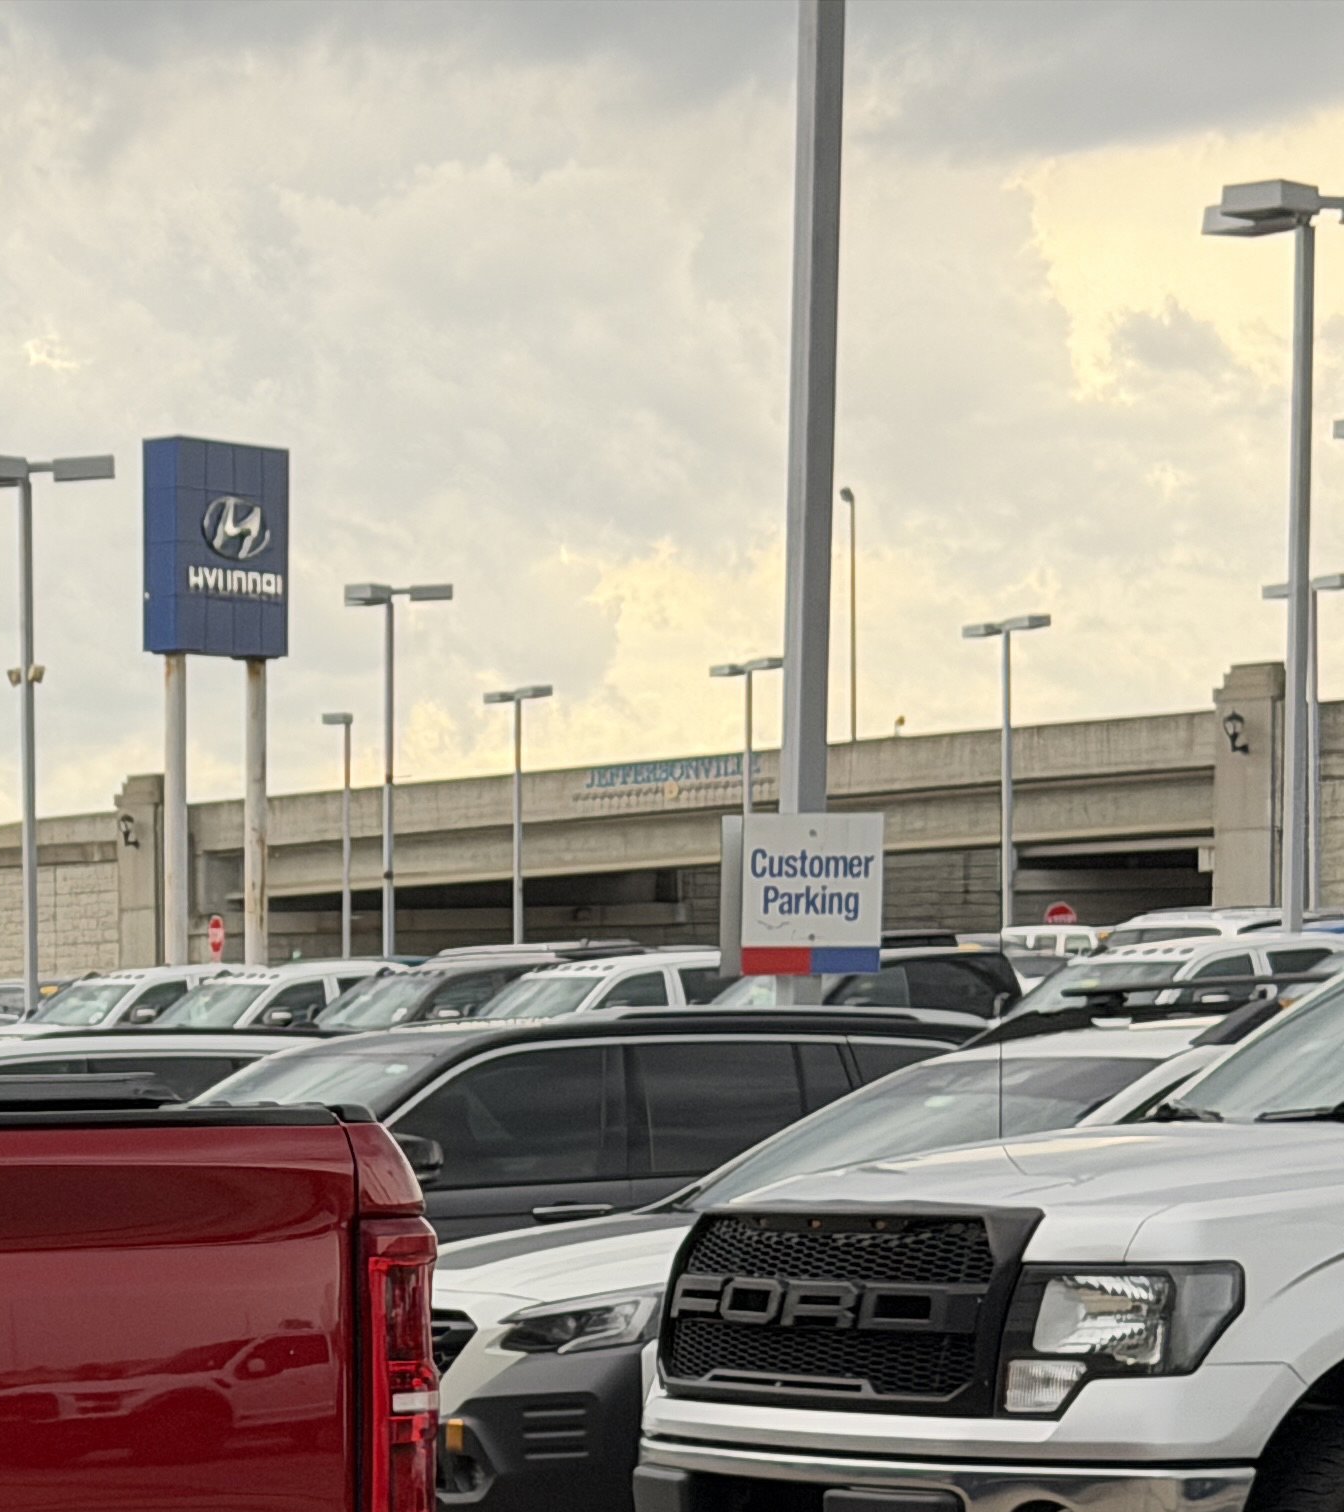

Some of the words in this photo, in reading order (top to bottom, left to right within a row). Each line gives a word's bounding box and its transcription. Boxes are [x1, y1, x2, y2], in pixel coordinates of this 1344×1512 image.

[189, 566, 282, 594] HYUNDAI
[751, 848, 875, 878] Customer
[763, 885, 860, 921] Parking
[670, 1273, 951, 1332] FORD
